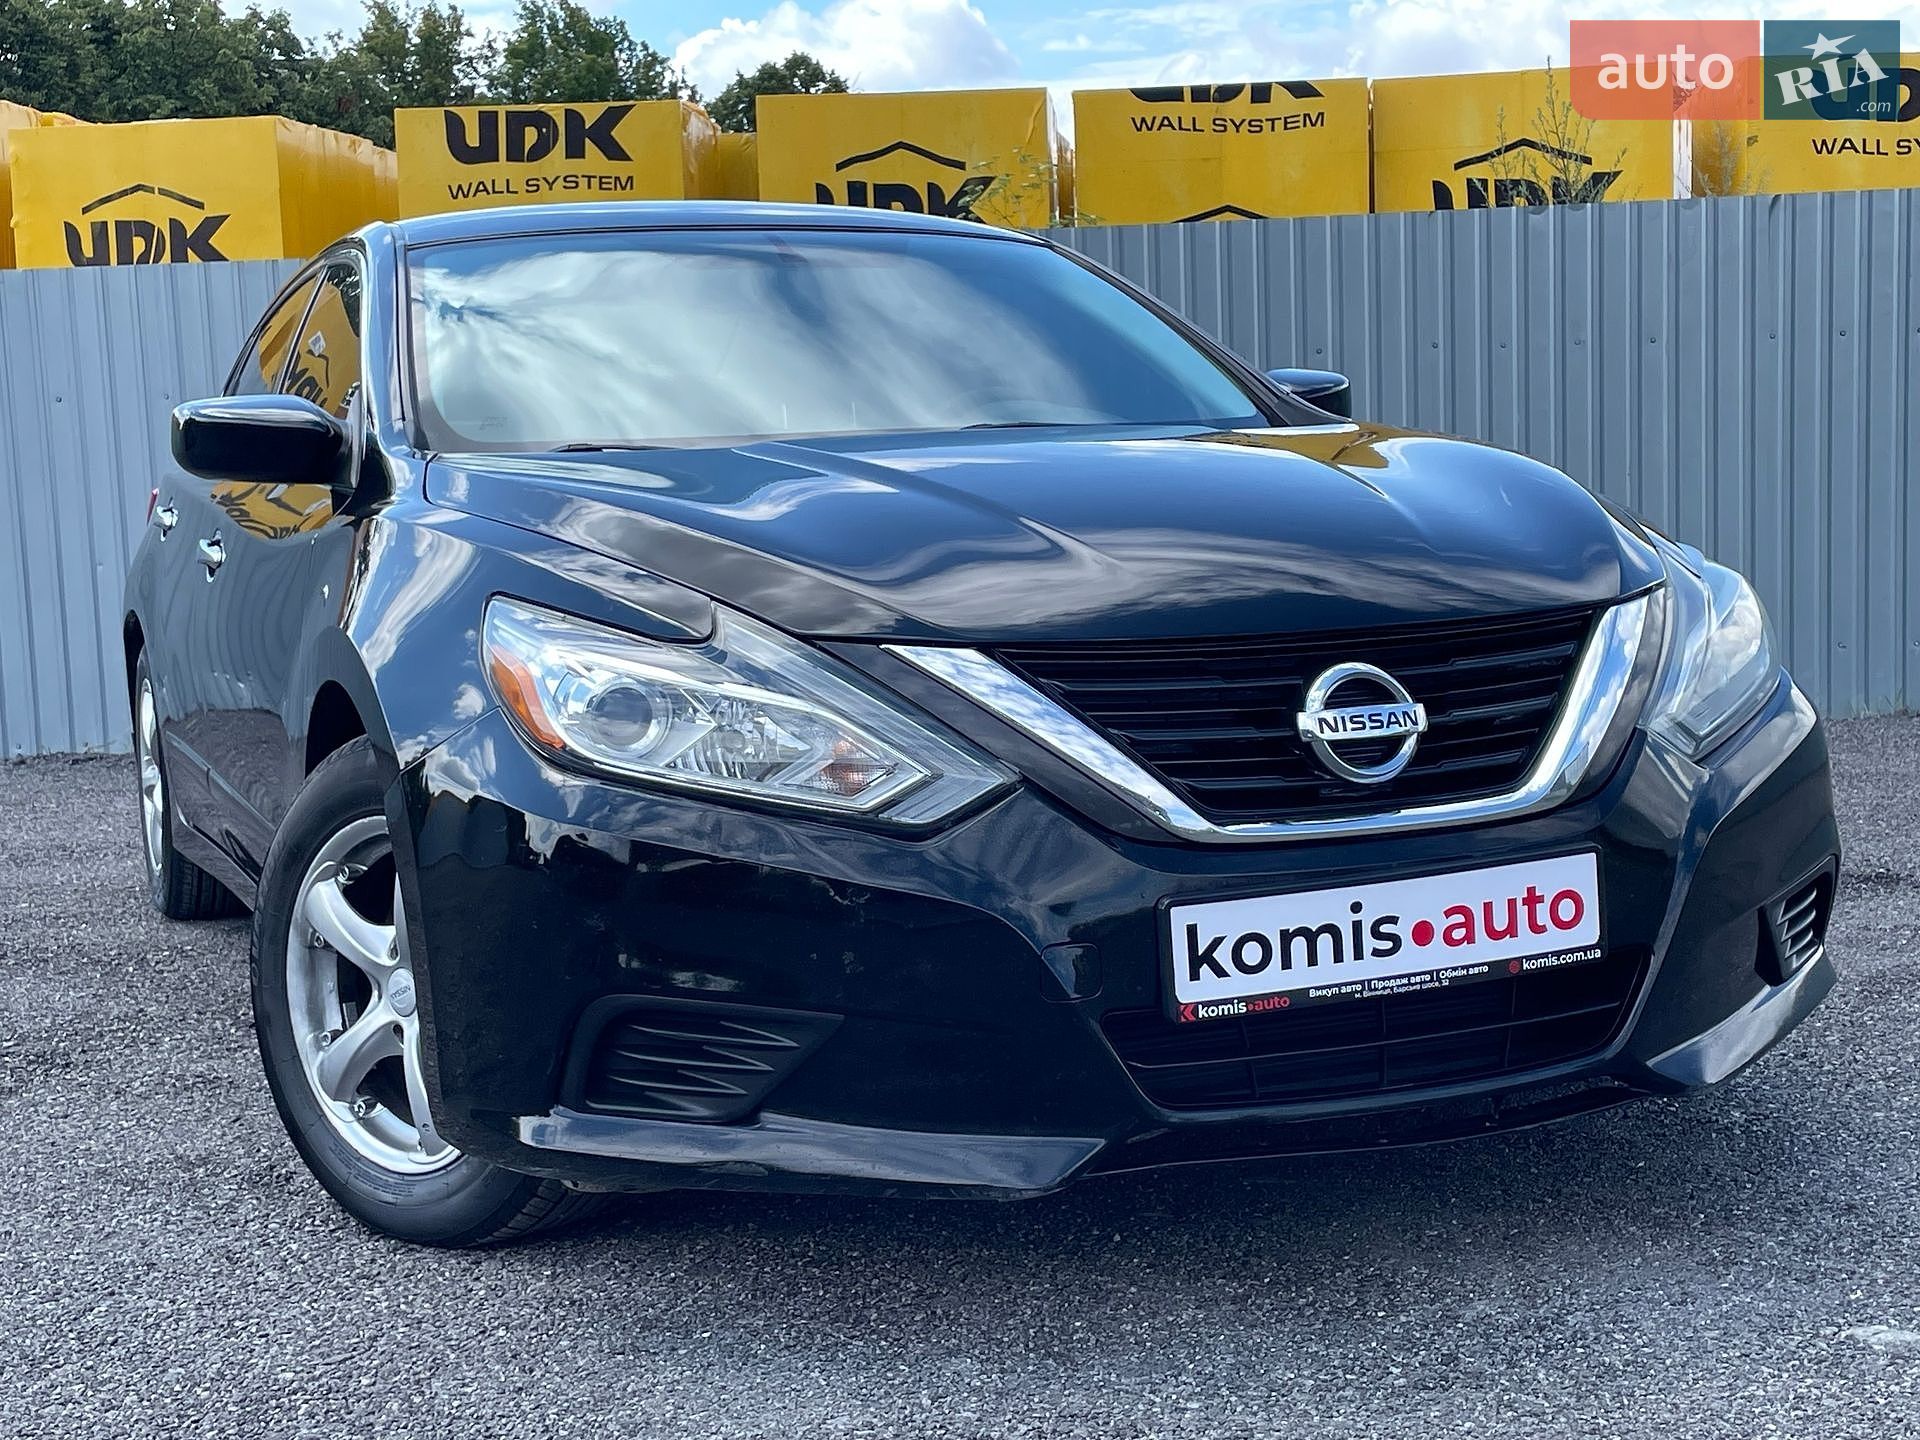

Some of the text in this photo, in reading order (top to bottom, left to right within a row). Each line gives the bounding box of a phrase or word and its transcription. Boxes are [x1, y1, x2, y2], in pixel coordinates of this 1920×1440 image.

[444, 104, 637, 165] UDK
[1131, 112, 1325, 133] WALL SYSTEM
[1811, 137, 1889, 156] WALL
[448, 174, 635, 200] WALL SYSTEM
[63, 213, 232, 267] UDK
[1317, 709, 1419, 734] NISSAN
[1522, 948, 1602, 971] komis.com.ua
[1309, 987, 1339, 998] Викуп
[1340, 983, 1362, 994] авто
[1410, 974, 1431, 984] авто
[1468, 965, 1489, 975] авто
